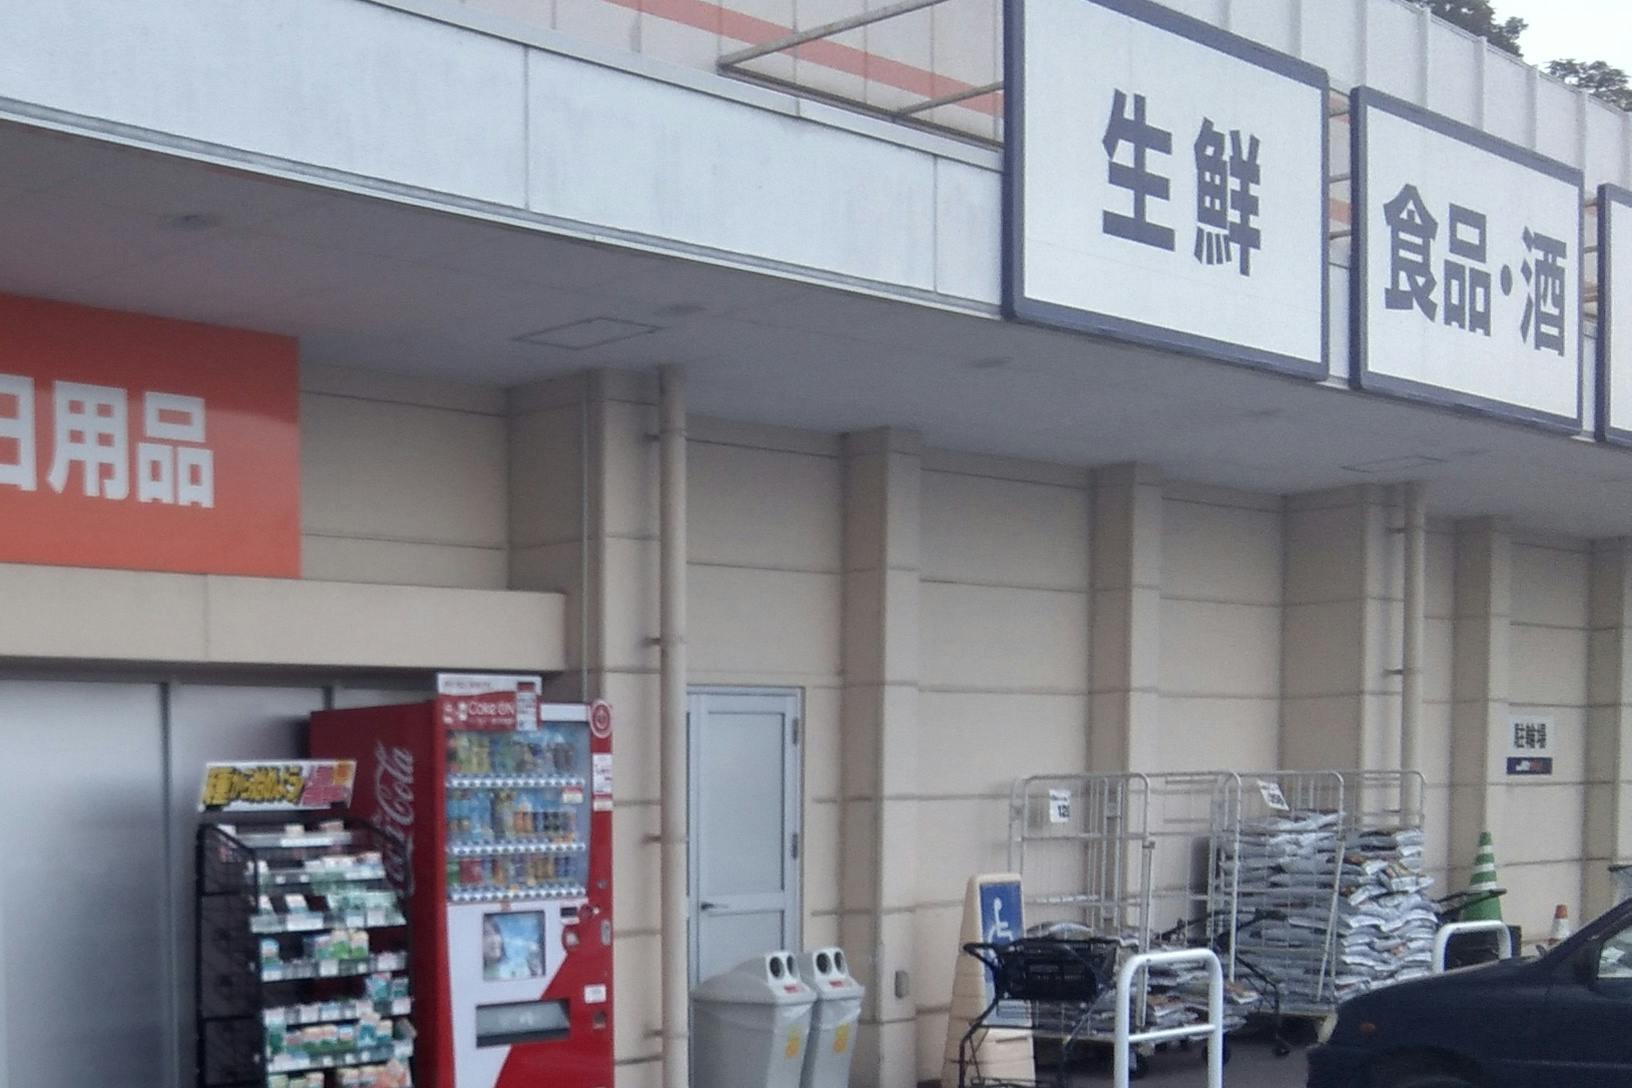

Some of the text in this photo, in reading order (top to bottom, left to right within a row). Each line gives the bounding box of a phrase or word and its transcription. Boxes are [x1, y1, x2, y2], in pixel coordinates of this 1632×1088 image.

[1102, 88, 1262, 277] 生鮮
[1383, 183, 1568, 357] 食品・酒
[1514, 723, 1546, 748] 駐輪場
